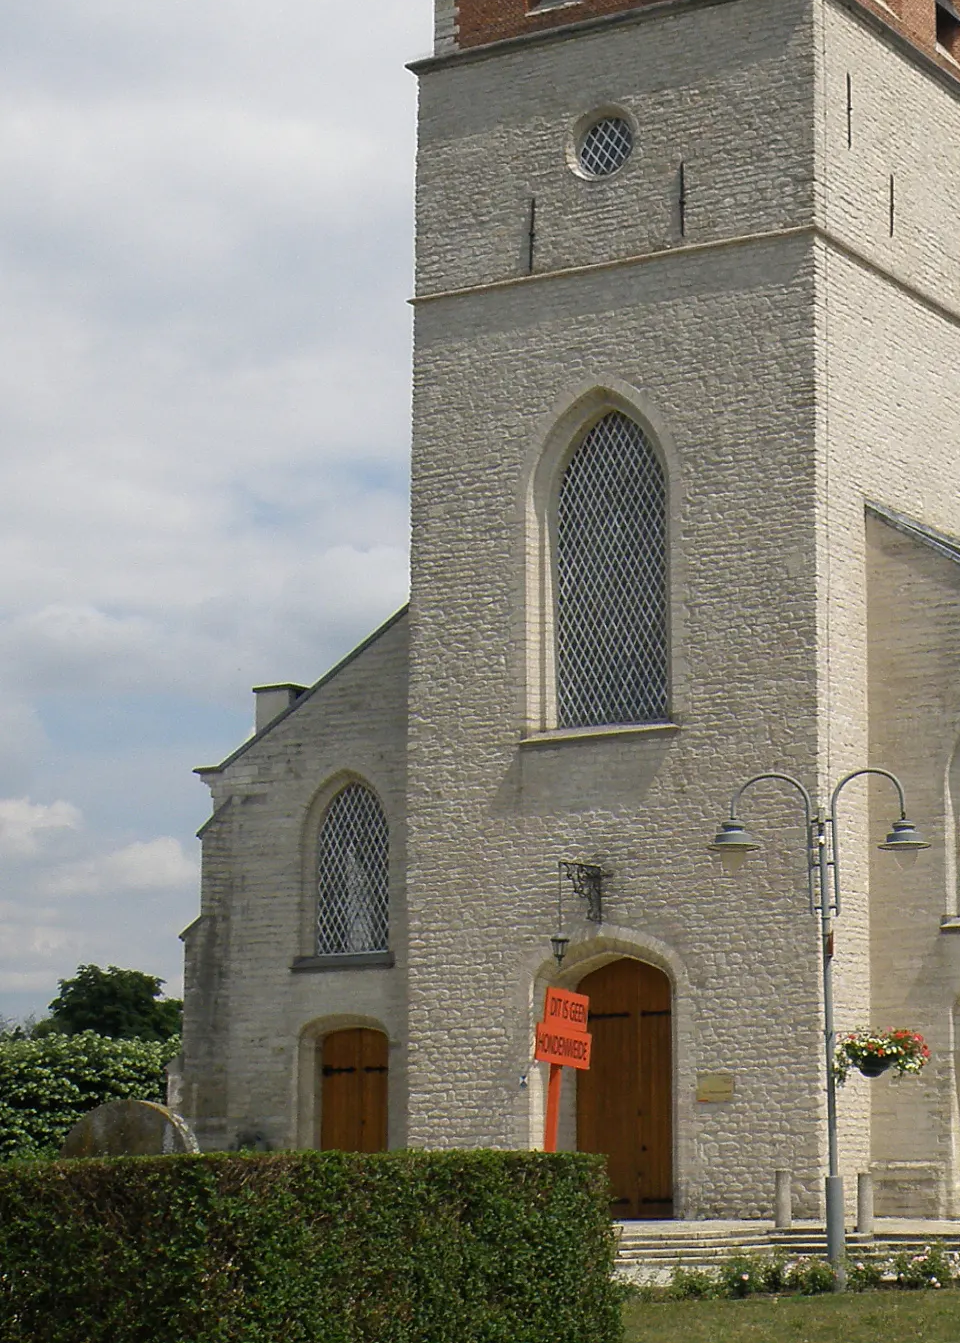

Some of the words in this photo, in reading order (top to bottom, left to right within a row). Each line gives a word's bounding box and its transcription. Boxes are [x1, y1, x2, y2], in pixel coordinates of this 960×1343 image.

[550, 997, 562, 1017] DIT
[563, 1000, 569, 1019] IS
[569, 1002, 587, 1024] GEEN
[537, 1032, 588, 1061] HONDENWEIDE
